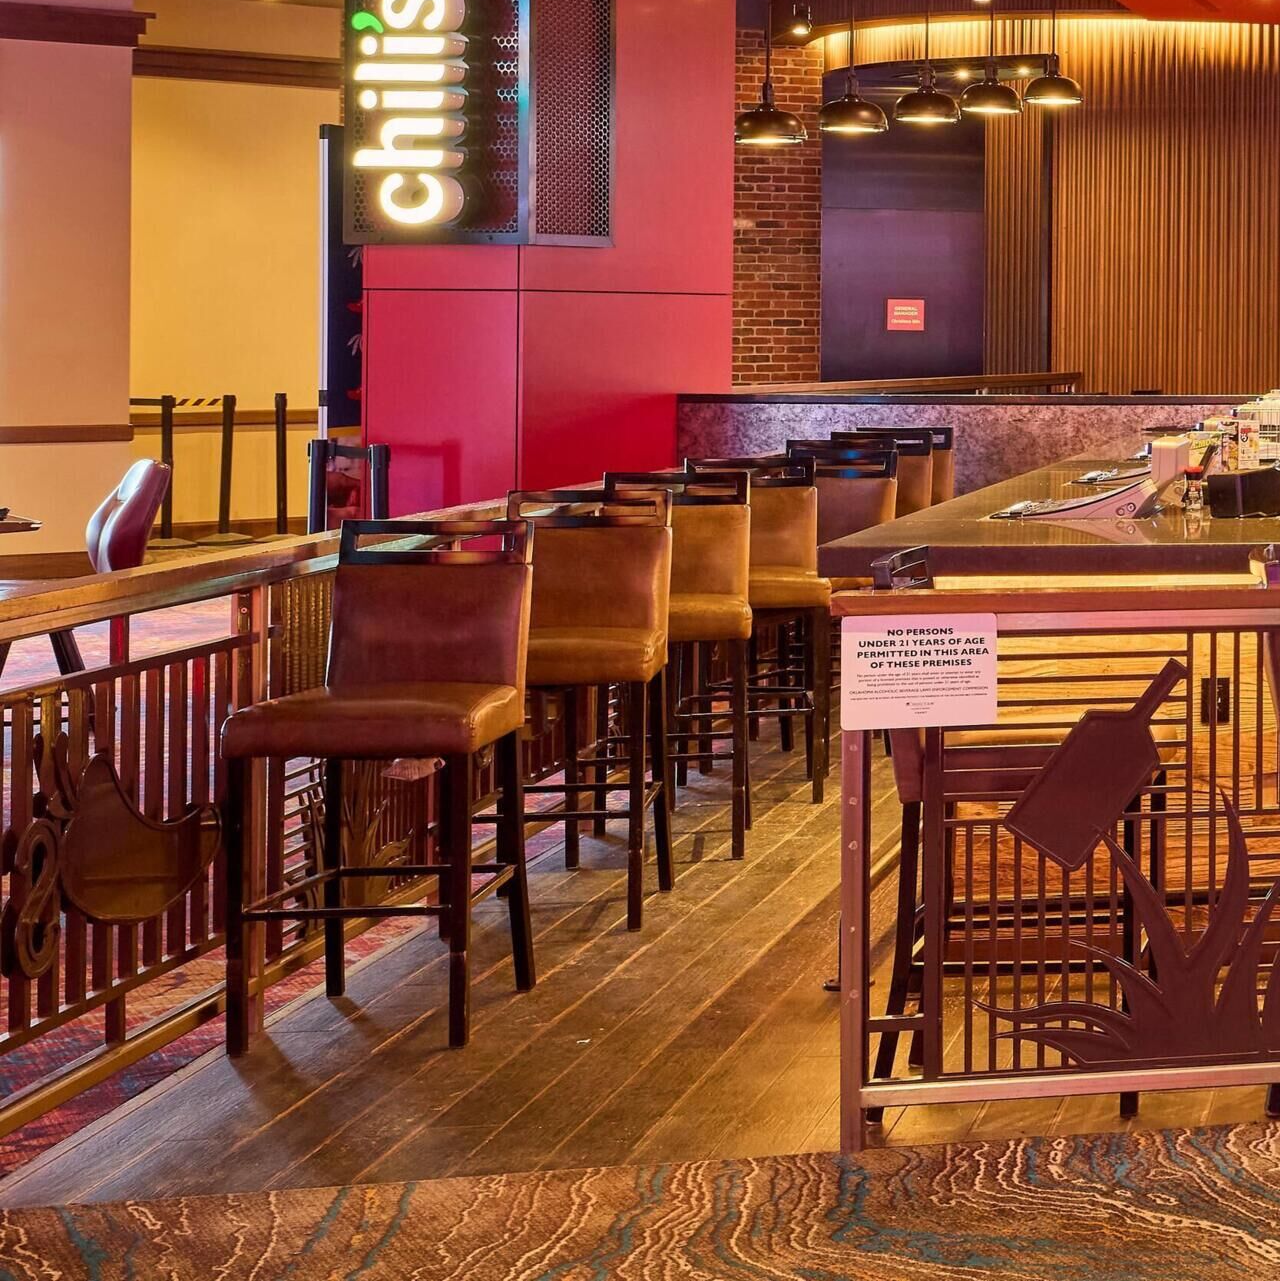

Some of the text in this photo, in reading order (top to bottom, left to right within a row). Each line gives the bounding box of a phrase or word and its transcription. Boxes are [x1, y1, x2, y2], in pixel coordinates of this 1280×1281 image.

[887, 627, 954, 637] NO PERSONS
[858, 637, 985, 648] UNDER 21 YEARS OF AGE
[857, 650, 918, 659] PERMITTED
[961, 647, 989, 655] AREA
[870, 658, 972, 669] OF THESE PREMISES
